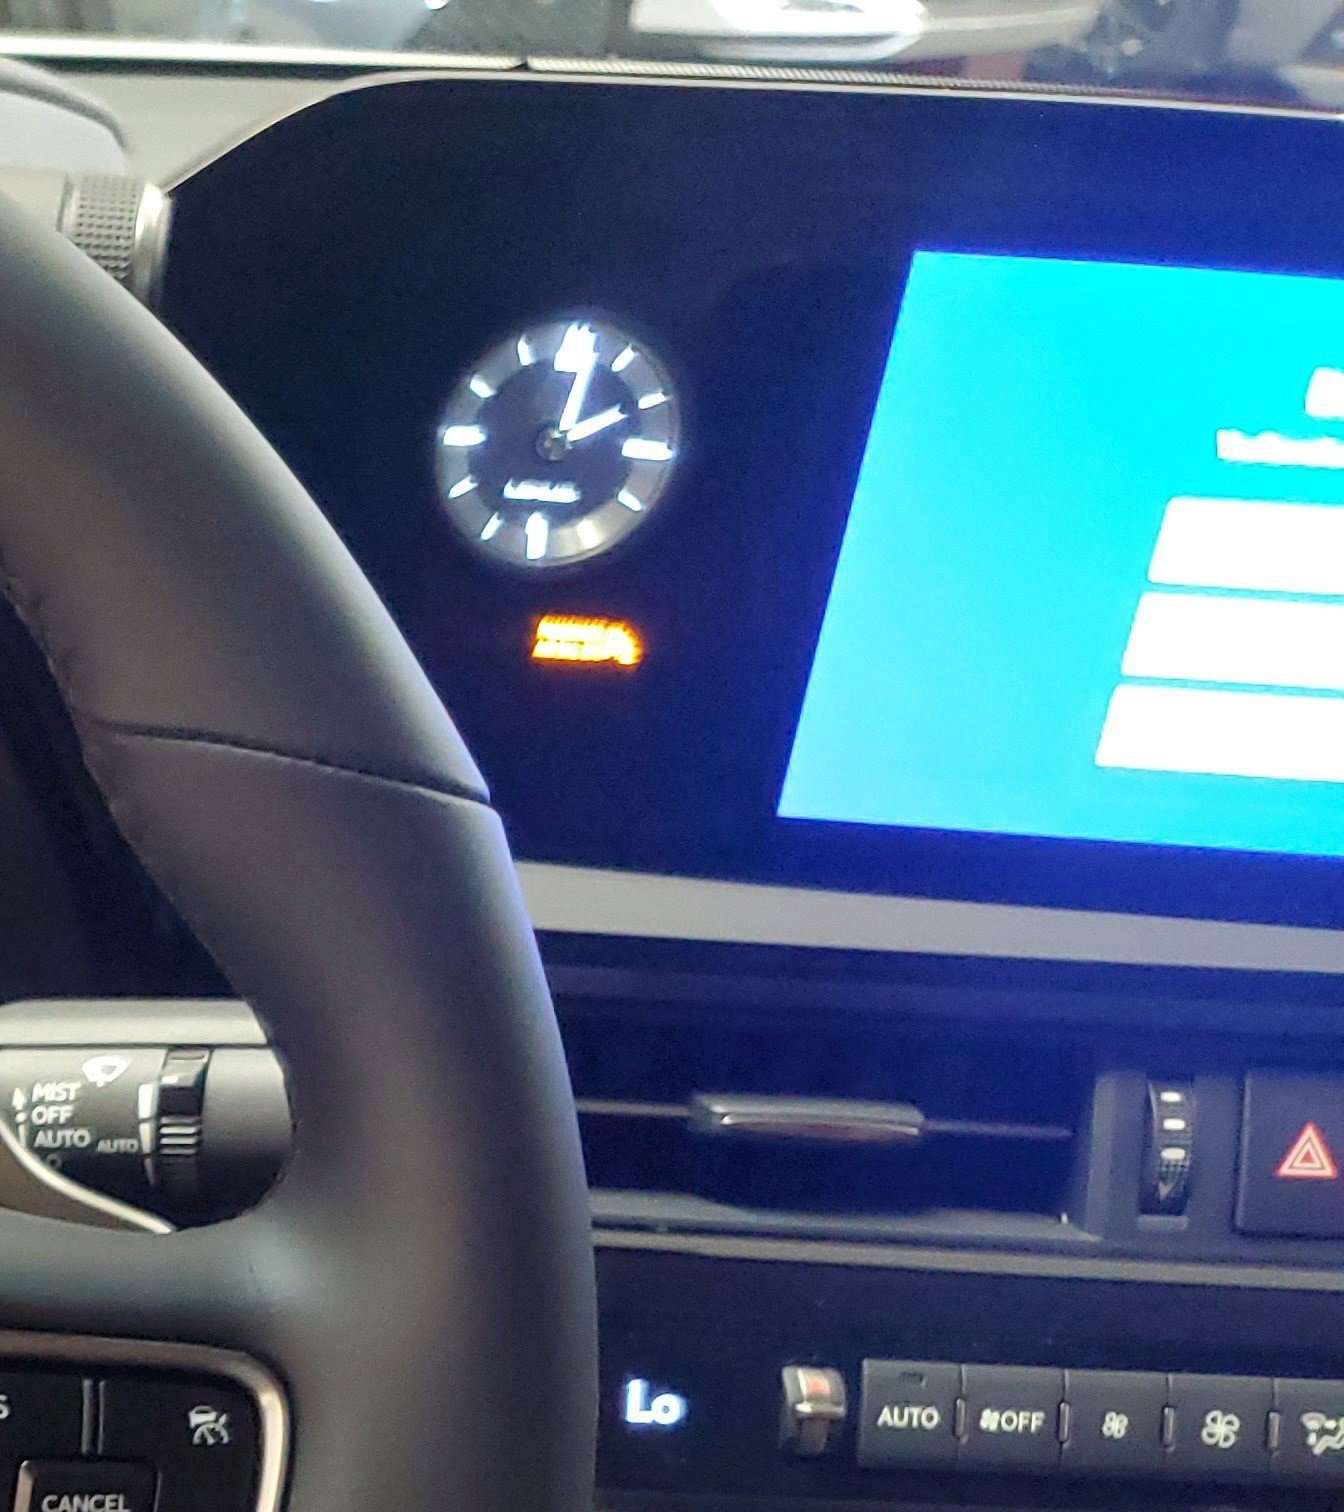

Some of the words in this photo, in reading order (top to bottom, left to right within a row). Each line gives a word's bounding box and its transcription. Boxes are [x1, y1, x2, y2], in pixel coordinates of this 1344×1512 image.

[31, 1081, 82, 1103] MIST
[31, 1105, 74, 1126] OFF
[33, 1128, 92, 1149] AUTO
[624, 1377, 686, 1426] Lo
[877, 1405, 940, 1430] AUTO
[1000, 1408, 1045, 1433] OFF
